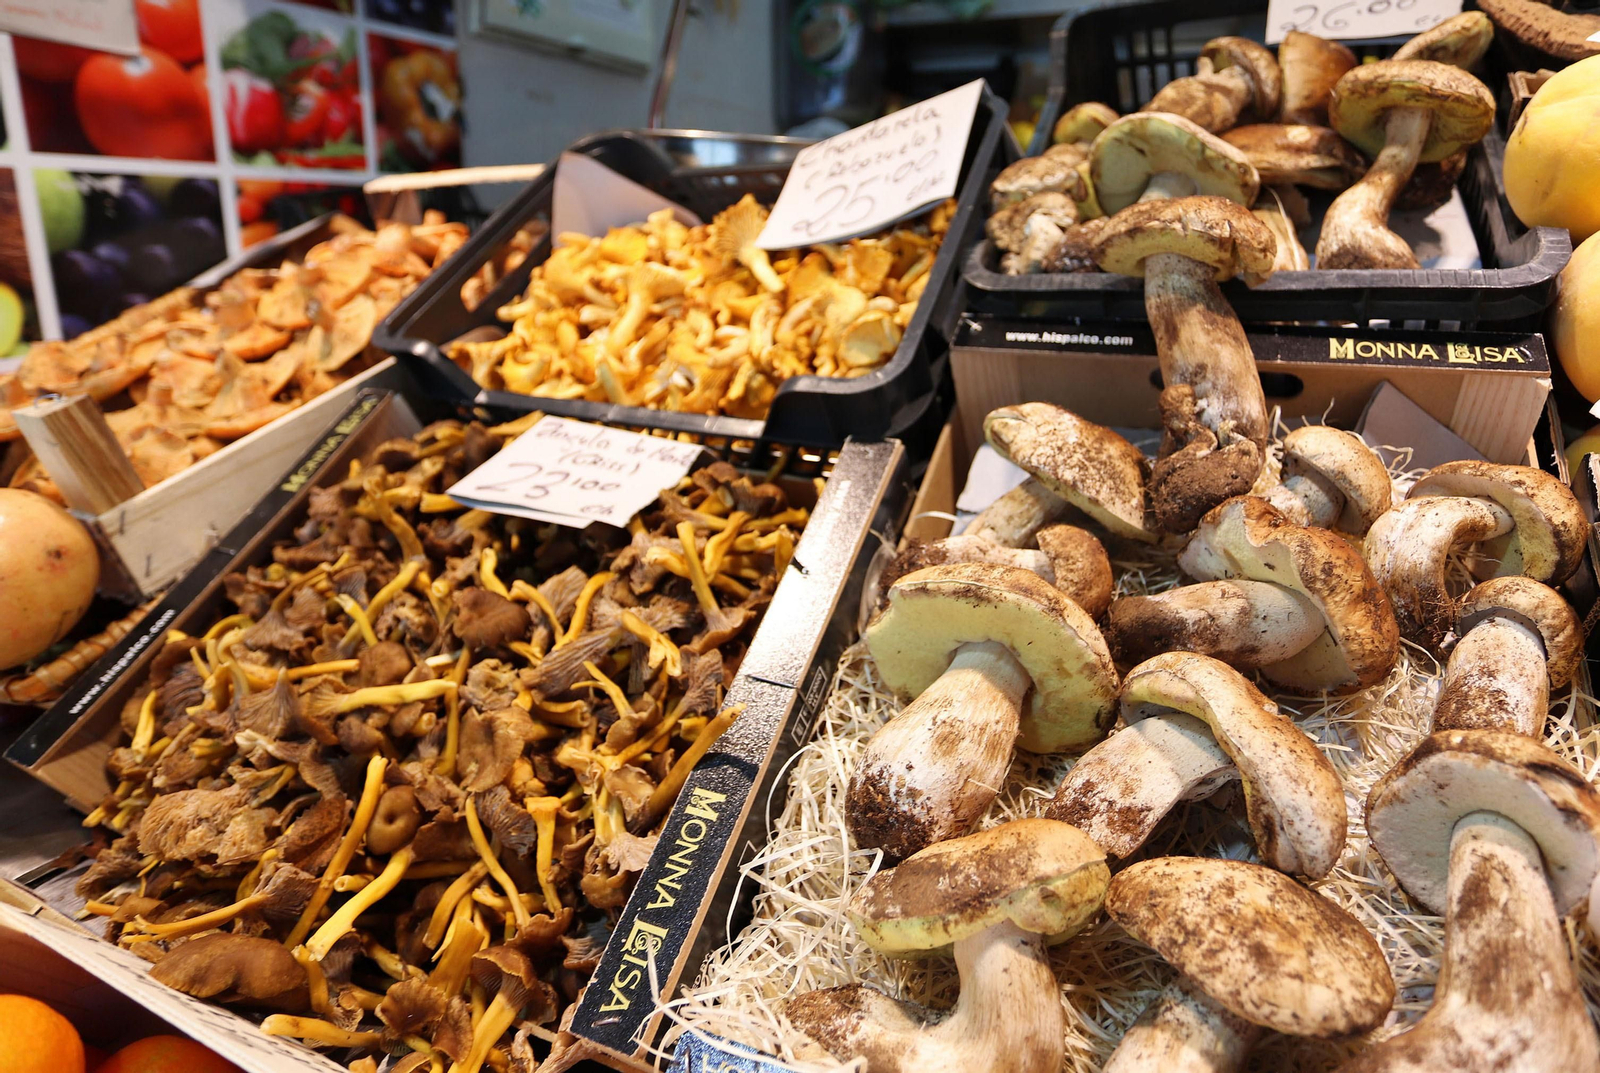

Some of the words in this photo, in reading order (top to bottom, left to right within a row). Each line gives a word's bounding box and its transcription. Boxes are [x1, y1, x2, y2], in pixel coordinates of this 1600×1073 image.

[1005, 330, 1134, 346] www.hispalco.com
[1328, 337, 1440, 360] MONNA
[1446, 341, 1526, 364] LISA
[68, 608, 176, 714] www.hispalco.com
[646, 786, 727, 910] MONNA
[599, 919, 670, 1013] LISA
